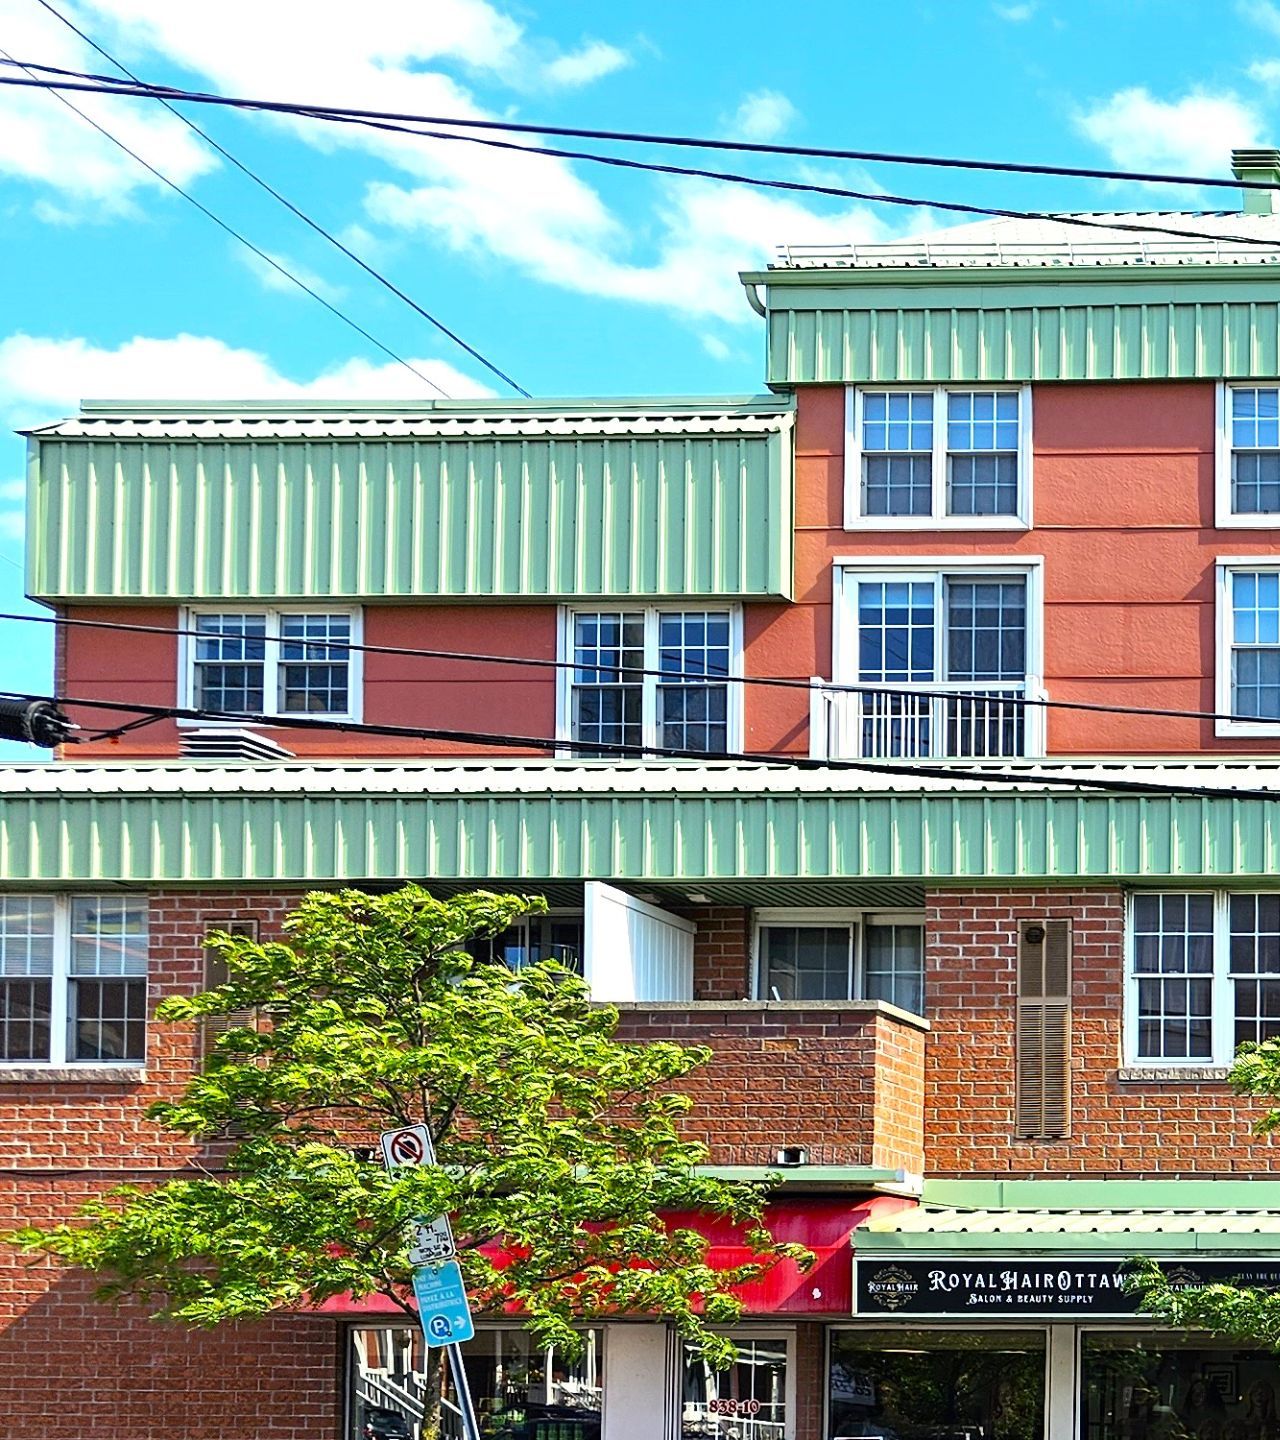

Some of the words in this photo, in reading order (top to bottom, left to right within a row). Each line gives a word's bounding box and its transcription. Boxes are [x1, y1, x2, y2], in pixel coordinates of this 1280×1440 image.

[966, 1293, 1002, 1305] SALON
[1006, 1294, 1013, 1304] &
[1017, 1294, 1053, 1304] BEAUTY
[1058, 1294, 1094, 1304] SUPPLY
[708, 1399, 760, 1415] 838-10
